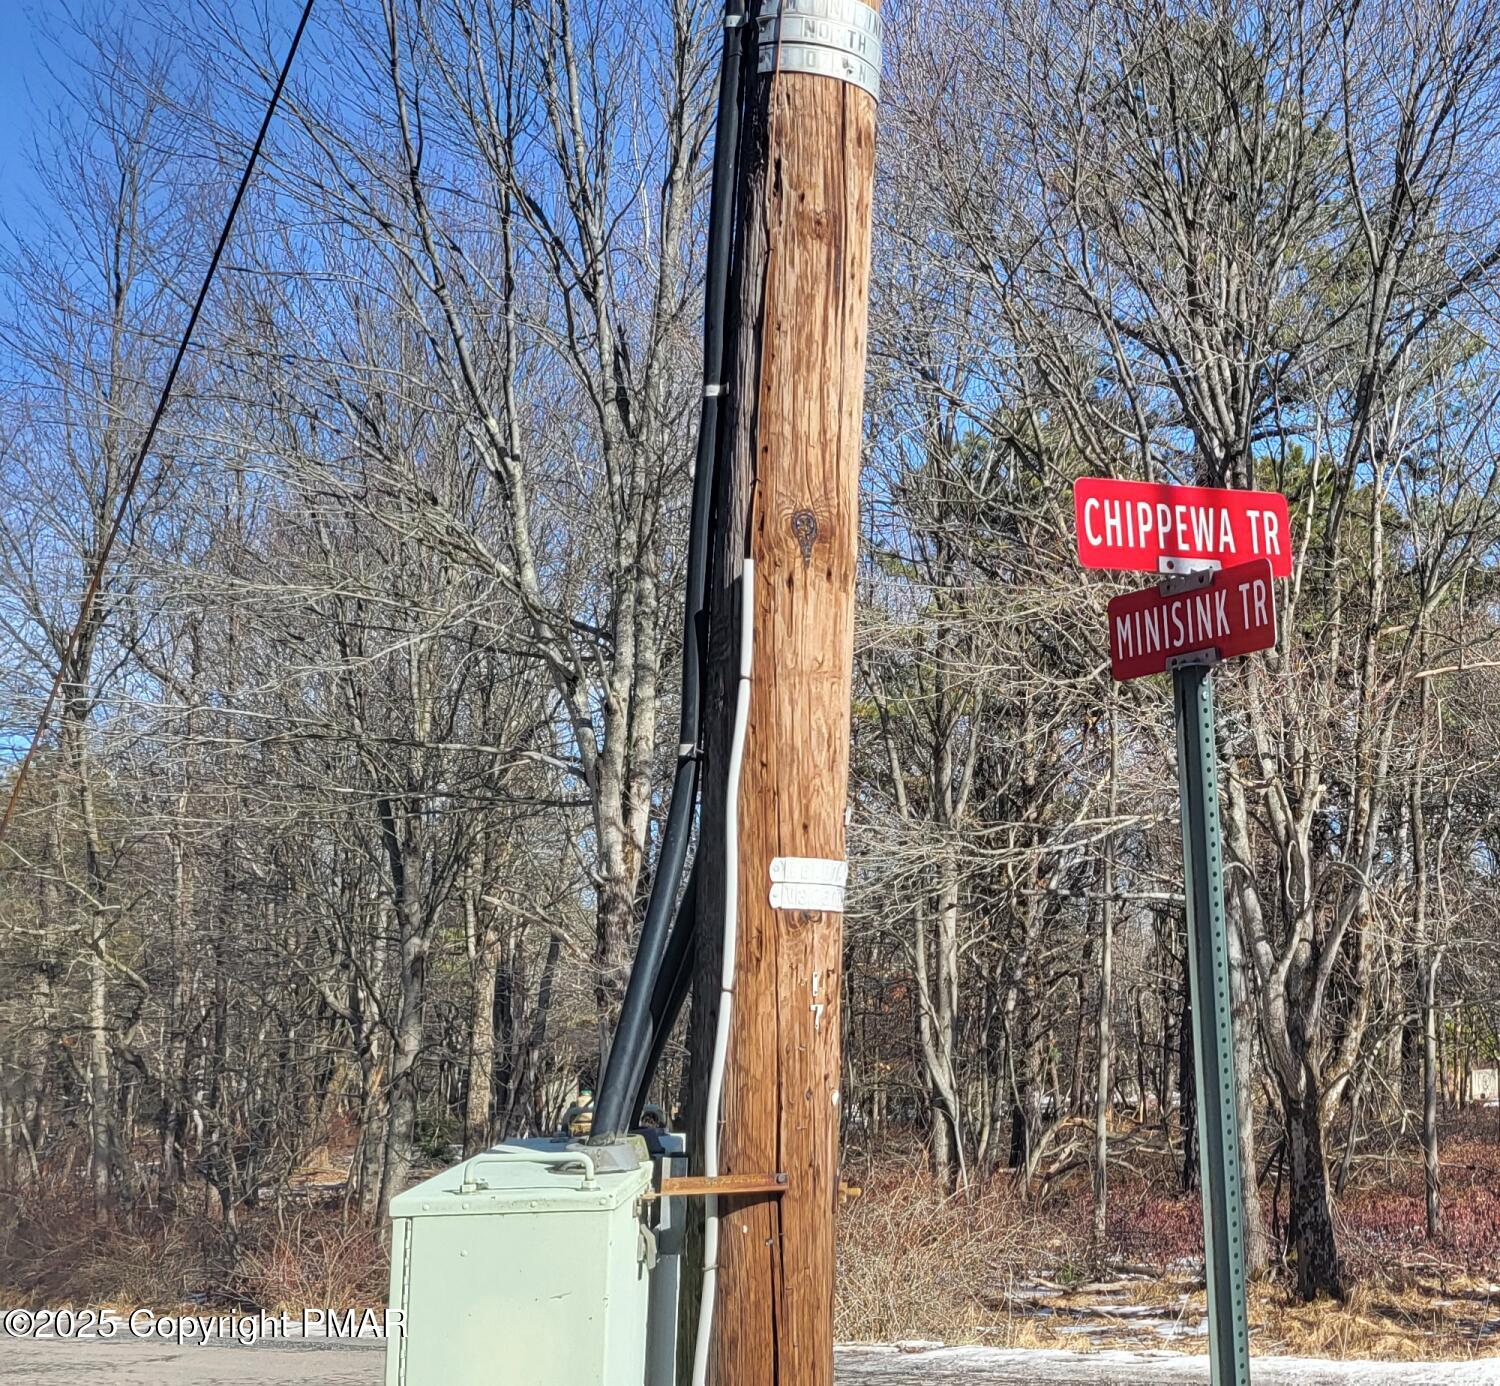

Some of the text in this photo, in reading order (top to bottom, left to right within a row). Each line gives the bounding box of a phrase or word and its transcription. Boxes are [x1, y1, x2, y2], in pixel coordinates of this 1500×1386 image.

[1084, 497, 1280, 555] CHIPPEWA TR
[1116, 579, 1268, 660] MINISINK TR
